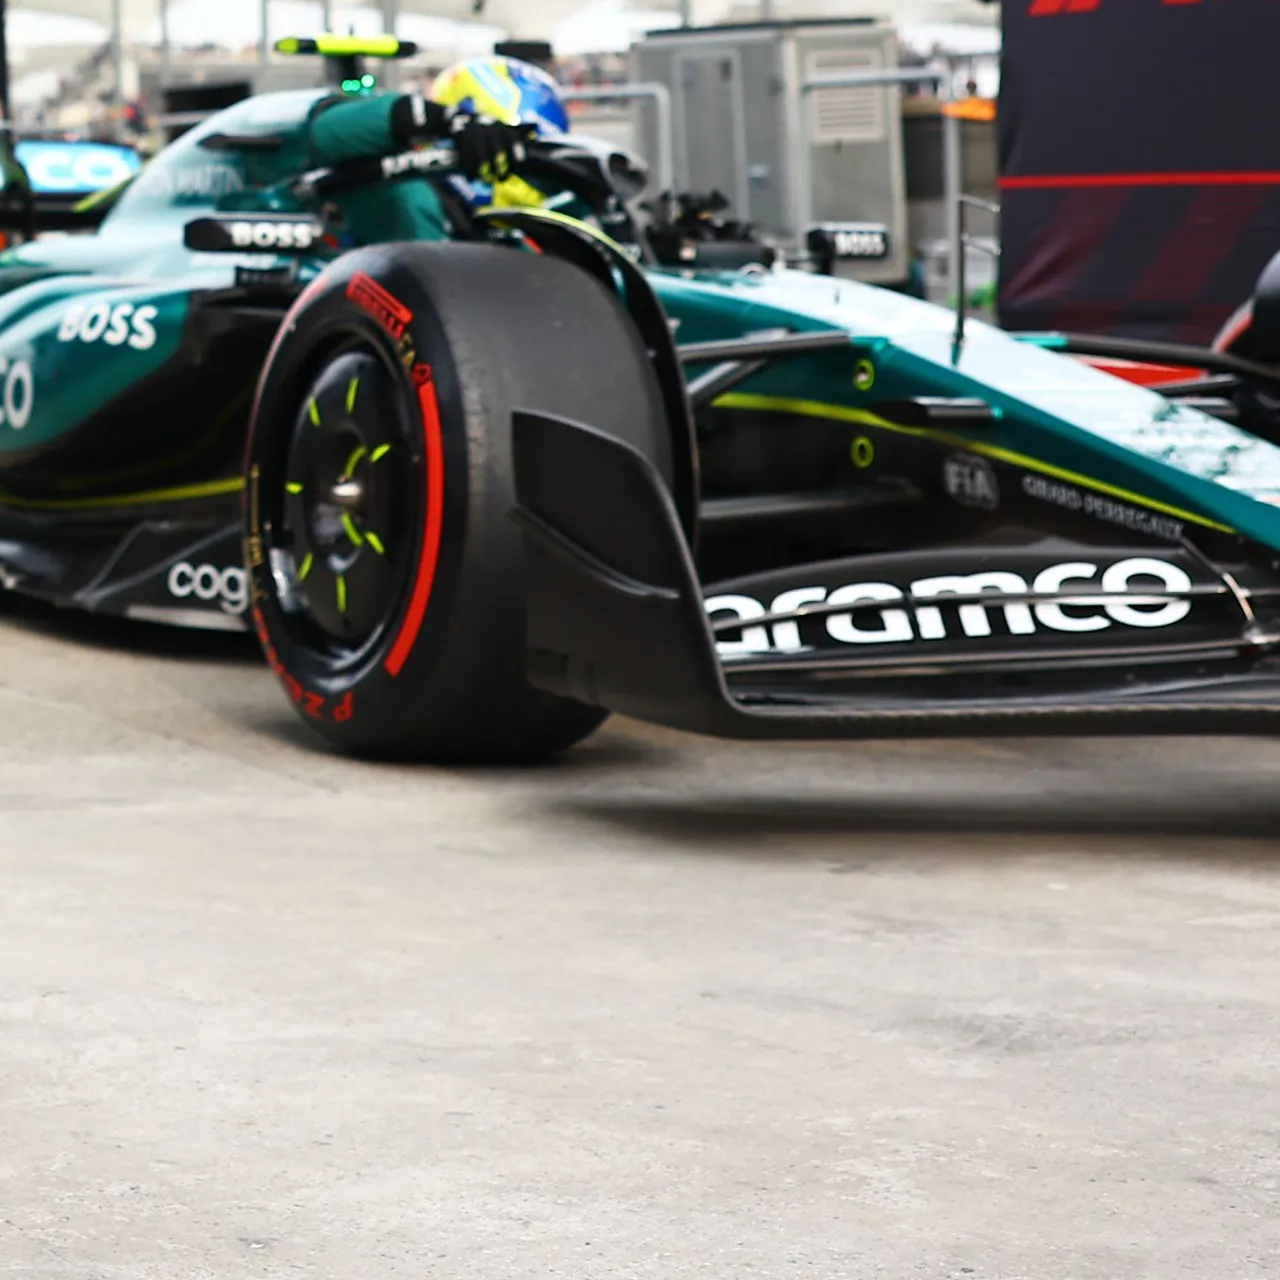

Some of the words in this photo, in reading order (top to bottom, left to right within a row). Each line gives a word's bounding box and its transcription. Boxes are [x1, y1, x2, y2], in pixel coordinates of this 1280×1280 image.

[230, 221, 313, 248] BOSS
[56, 302, 159, 350] BOSS
[701, 557, 1192, 655] aramco
